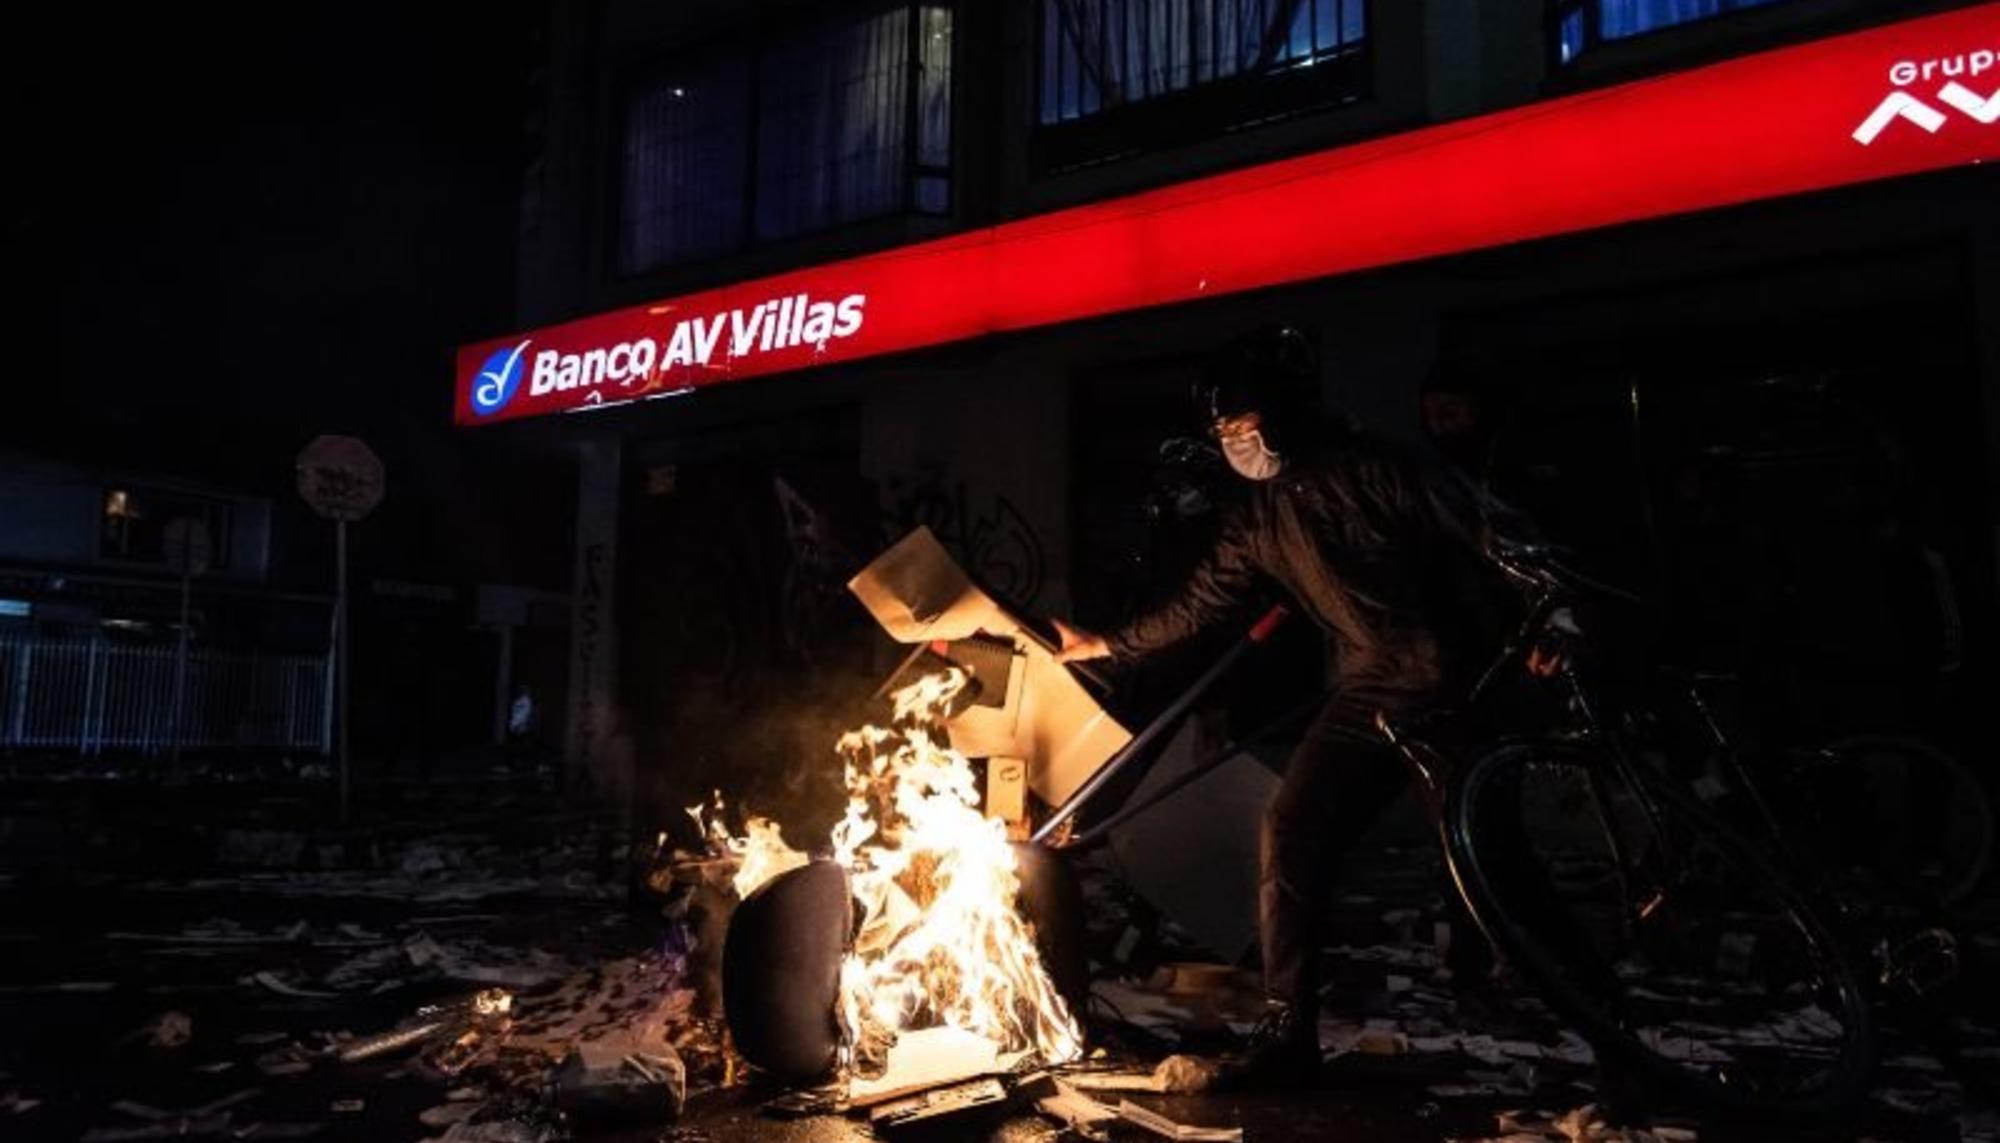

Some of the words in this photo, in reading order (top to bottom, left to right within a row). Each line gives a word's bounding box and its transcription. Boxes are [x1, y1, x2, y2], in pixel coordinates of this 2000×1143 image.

[1889, 49, 2000, 86] Grup
[529, 337, 657, 396] Banco
[659, 311, 729, 372] AV
[728, 292, 867, 359] Villas
